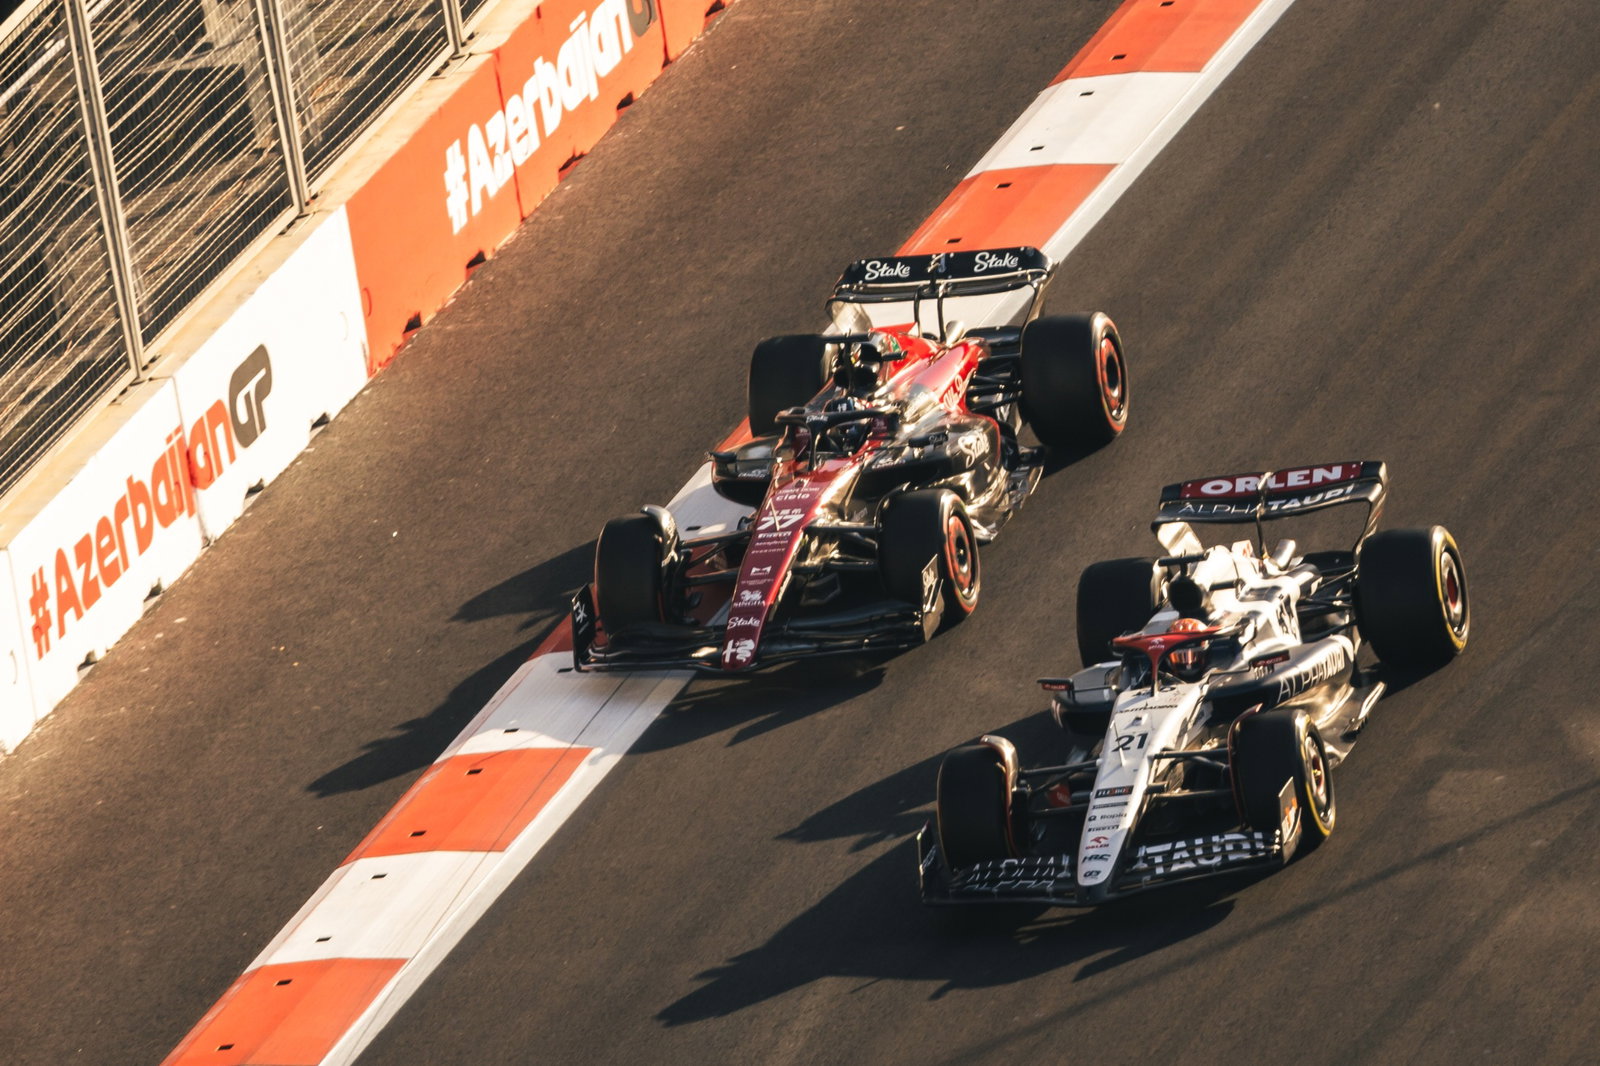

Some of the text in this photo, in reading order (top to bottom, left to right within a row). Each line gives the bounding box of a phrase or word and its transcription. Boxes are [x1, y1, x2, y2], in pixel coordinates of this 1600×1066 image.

[865, 260, 910, 280] Stake
[973, 251, 1019, 273] Stake
[1201, 465, 1343, 495] ORLEN
[29, 343, 272, 661] #AzerbaijanGP
[757, 513, 805, 531] 77
[727, 616, 760, 630] Stake
[1111, 732, 1149, 752] 21
